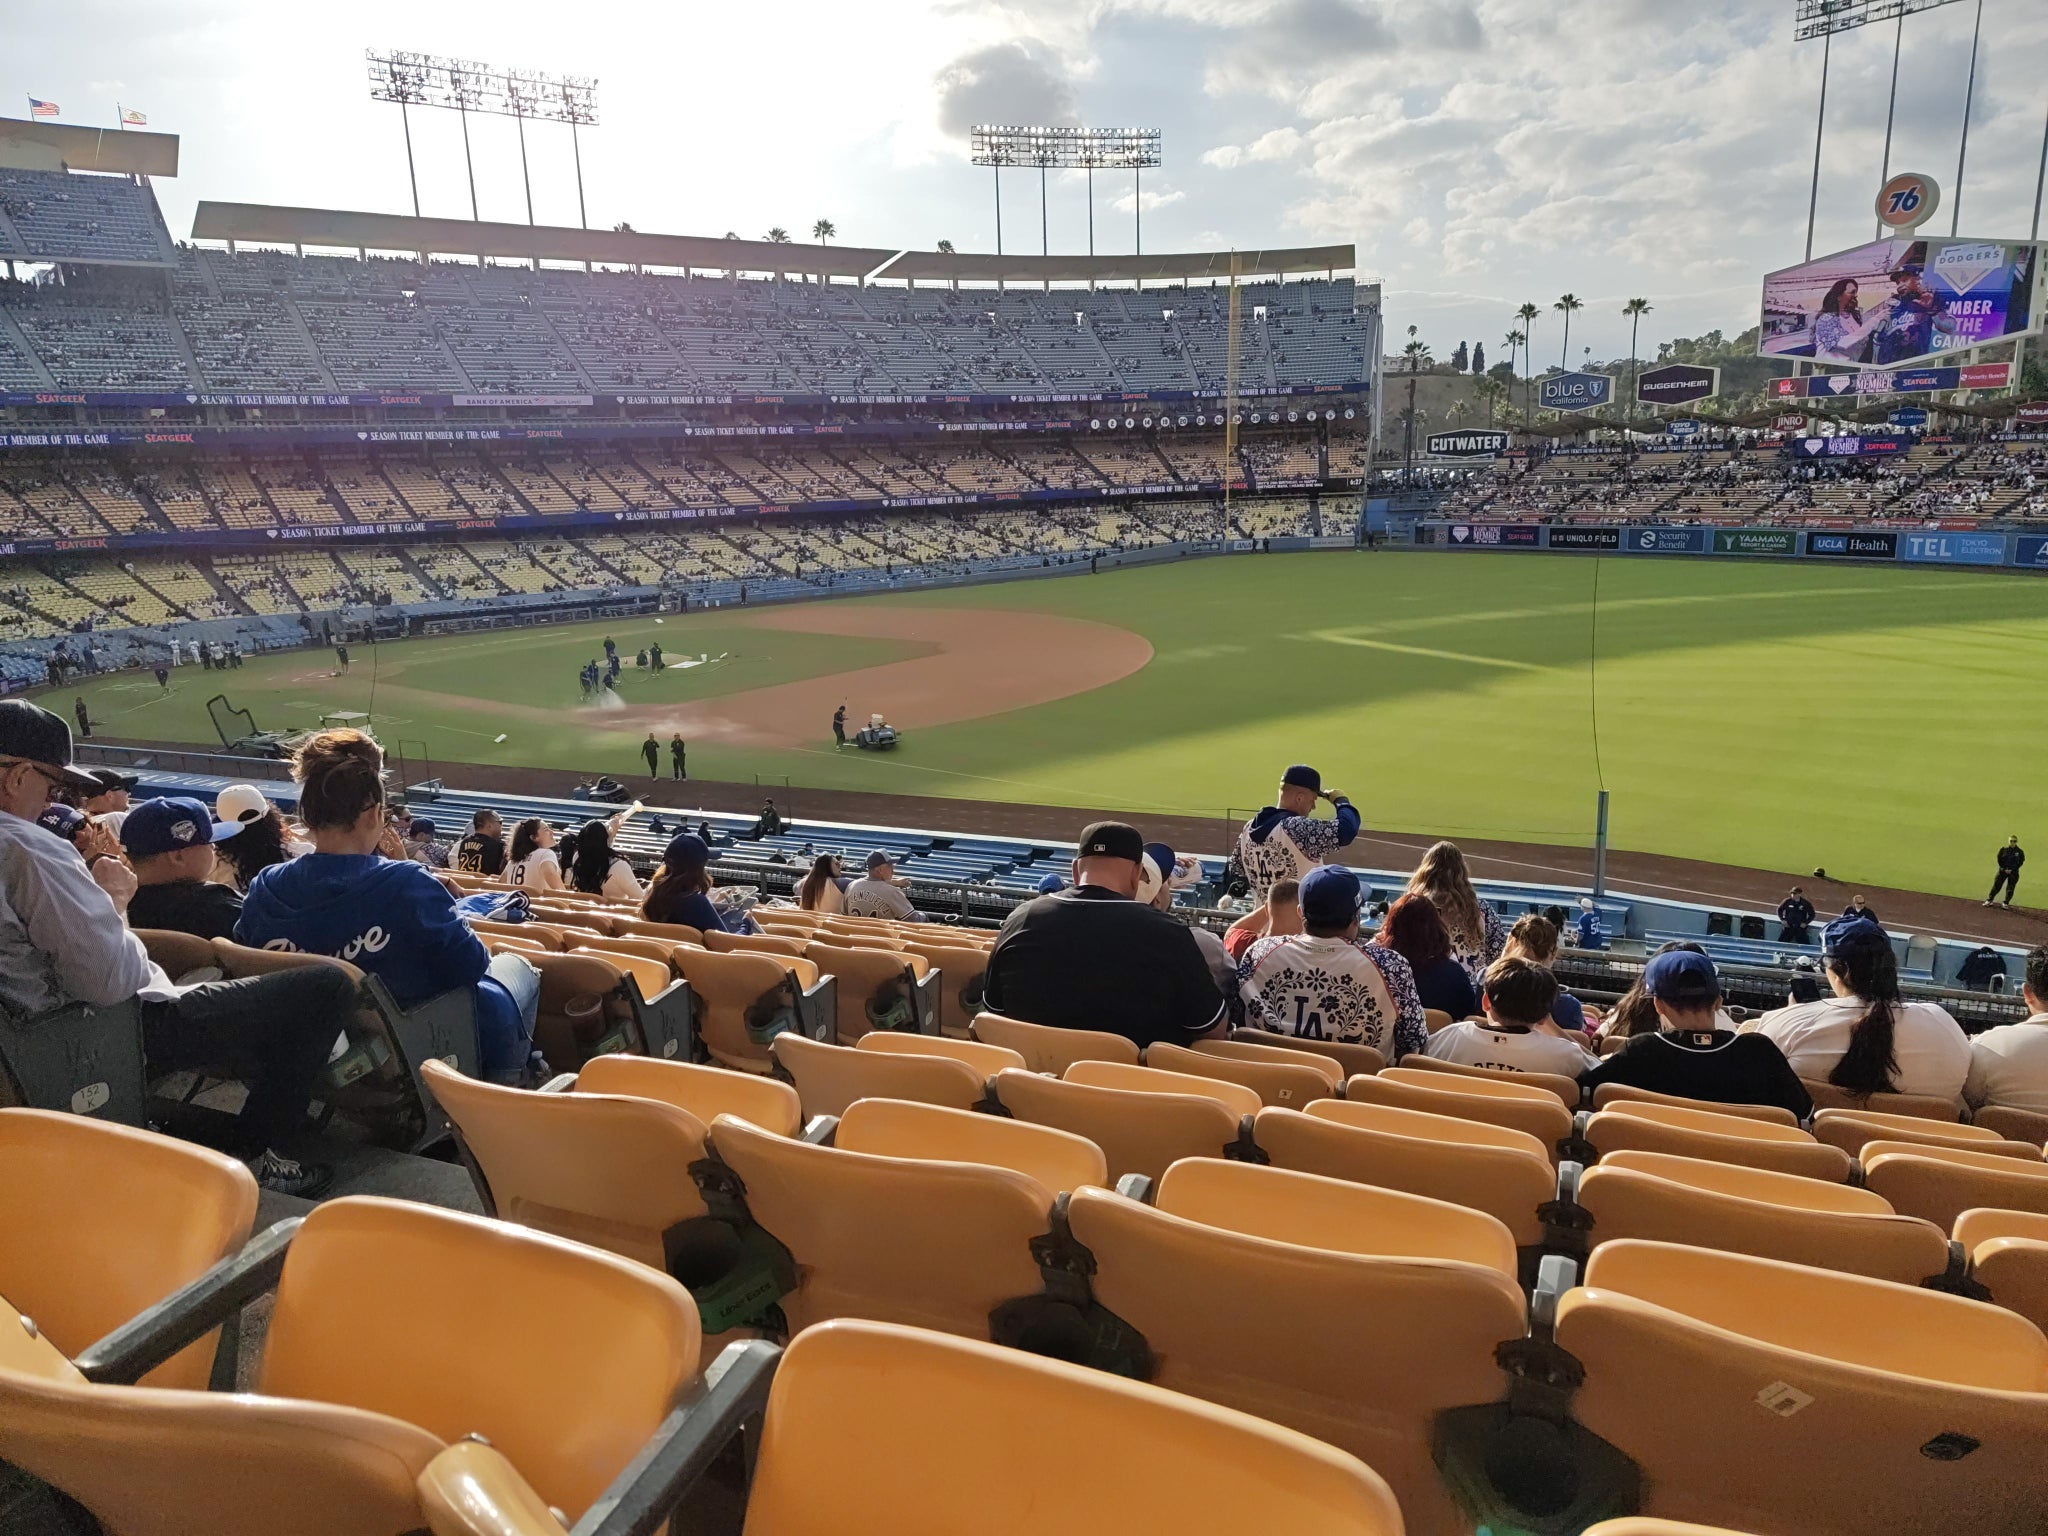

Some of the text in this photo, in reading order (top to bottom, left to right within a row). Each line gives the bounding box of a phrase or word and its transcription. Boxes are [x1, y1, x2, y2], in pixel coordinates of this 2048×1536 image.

[1886, 185, 1921, 215] 76
[1939, 250, 2000, 264] DODGERS
[1955, 318, 1984, 332] THE
[1643, 380, 1708, 391] GUGGENHEIM
[1902, 377, 1937, 386] SEATGEEK
[1546, 381, 1584, 398] blue
[36, 394, 87, 404] SEATGEEK
[201, 395, 232, 405] SEASON
[235, 395, 262, 405] TICKET
[264, 395, 297, 405] MEMBER
[300, 395, 310, 405] OF
[312, 395, 326, 405] THE
[328, 395, 350, 405] GAME
[627, 396, 648, 404] SEASON
[650, 396, 669, 404] TICKET
[672, 396, 694, 404] MEMBER
[704, 396, 715, 404] THE
[1551, 397, 1588, 405] california
[1777, 416, 1803, 427] JINRO
[11, 433, 194, 445] MEMBER OF THE GAME SEATGEEK
[371, 429, 563, 441] SEASON TICKET MEMBER OF THE GAME SEATGEEK
[1431, 436, 1501, 451] CUTWATER
[1828, 442, 1859, 451] MEMBER
[1146, 486, 1165, 494] MEMBER
[1174, 485, 1184, 493] THE
[626, 505, 790, 520] SEASON TICKET MEMBER OF THE GAME SEATGEEK
[282, 519, 496, 538] SEASON TICKET MEMBER OF THE GAME SEATGEEK
[1473, 531, 1501, 540] MEMBER
[1567, 535, 1593, 543] UNIQLO
[1658, 531, 1691, 541] Security
[1740, 535, 1787, 544] YAAMAVA
[54, 538, 108, 550] SEATGEEK
[1658, 540, 1686, 549] Benefit
[1818, 539, 1888, 551] UCLA Health
[1910, 538, 1952, 557] TEL
[42, 814, 61, 826] LA
[460, 852, 482, 872] 24
[1256, 851, 1272, 885] LA
[511, 864, 526, 885] 18
[1291, 995, 1333, 1042] LA
[81, 1085, 99, 1099] 152
